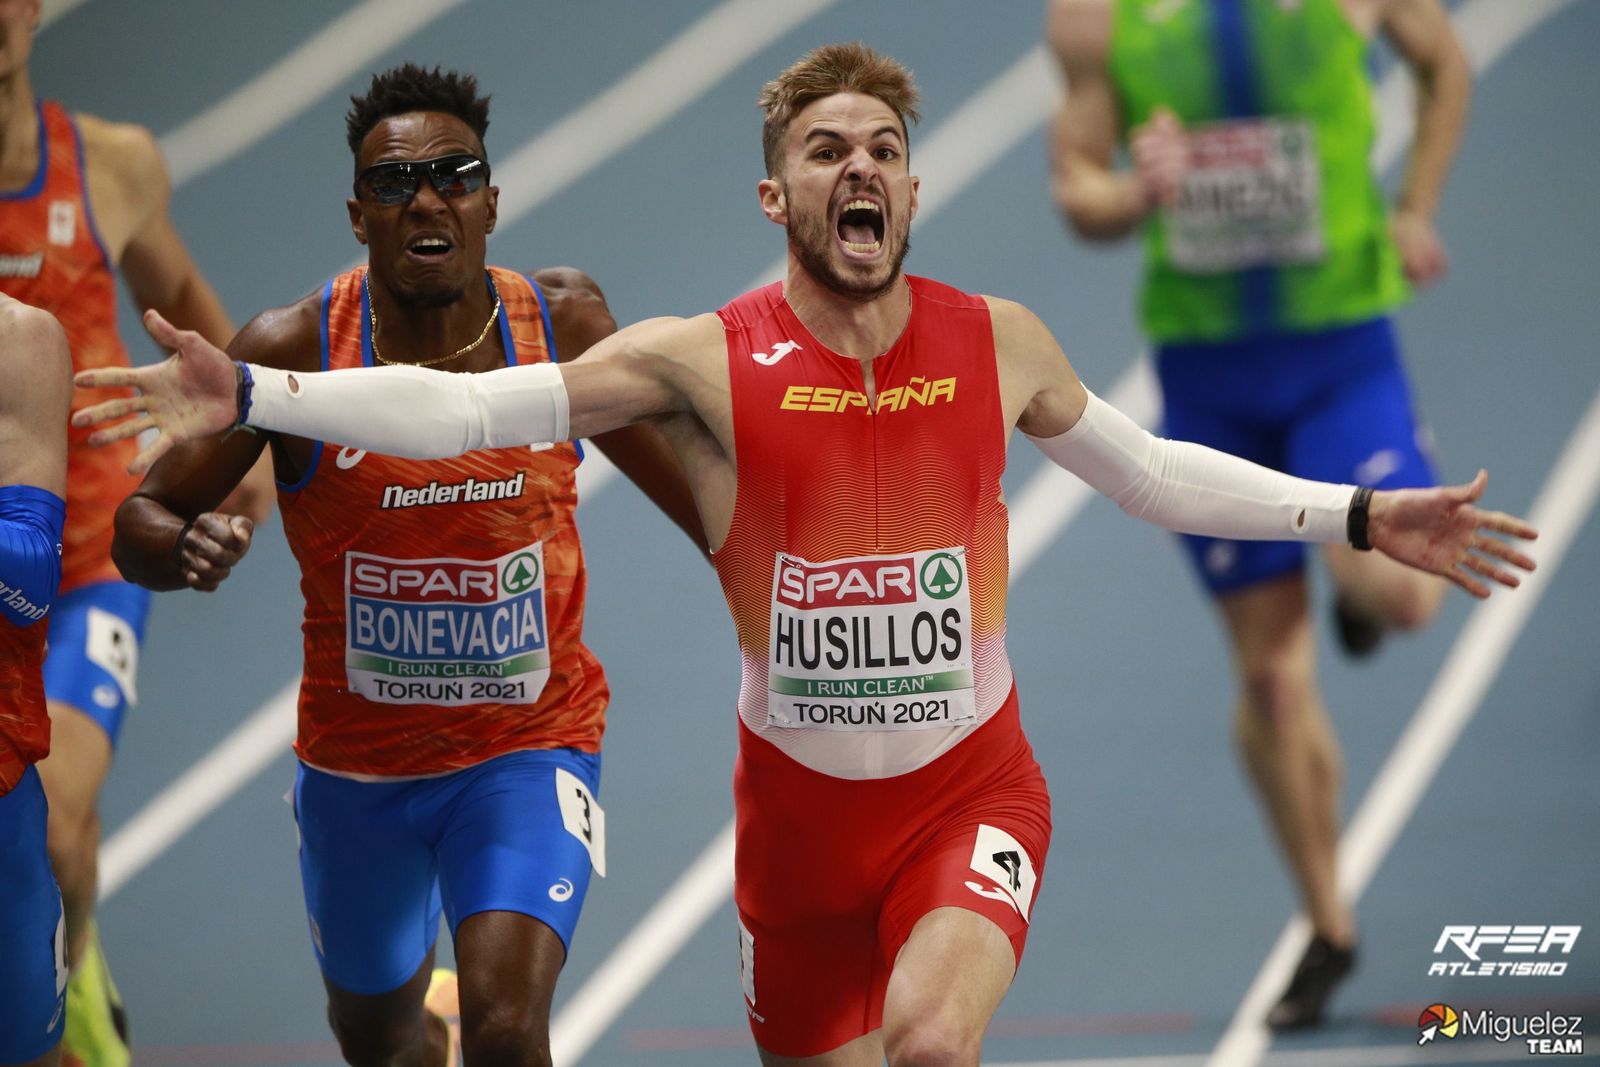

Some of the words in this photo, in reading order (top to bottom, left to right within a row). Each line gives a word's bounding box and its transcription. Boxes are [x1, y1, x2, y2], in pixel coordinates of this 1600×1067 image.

[779, 376, 957, 416] ESPAÑA
[354, 563, 494, 597] SPAR
[780, 566, 912, 603] SPAR
[355, 597, 541, 656] BONEVACIA
[775, 607, 962, 670] HUSILLOS
[399, 663, 439, 676] RUN
[373, 679, 463, 700] TORUŃ
[470, 681, 526, 699] 2021
[807, 682, 812, 695] I
[817, 681, 858, 696] RUN
[793, 701, 887, 725] TORUŃ
[893, 699, 950, 724] 2021
[575, 788, 592, 844] 3
